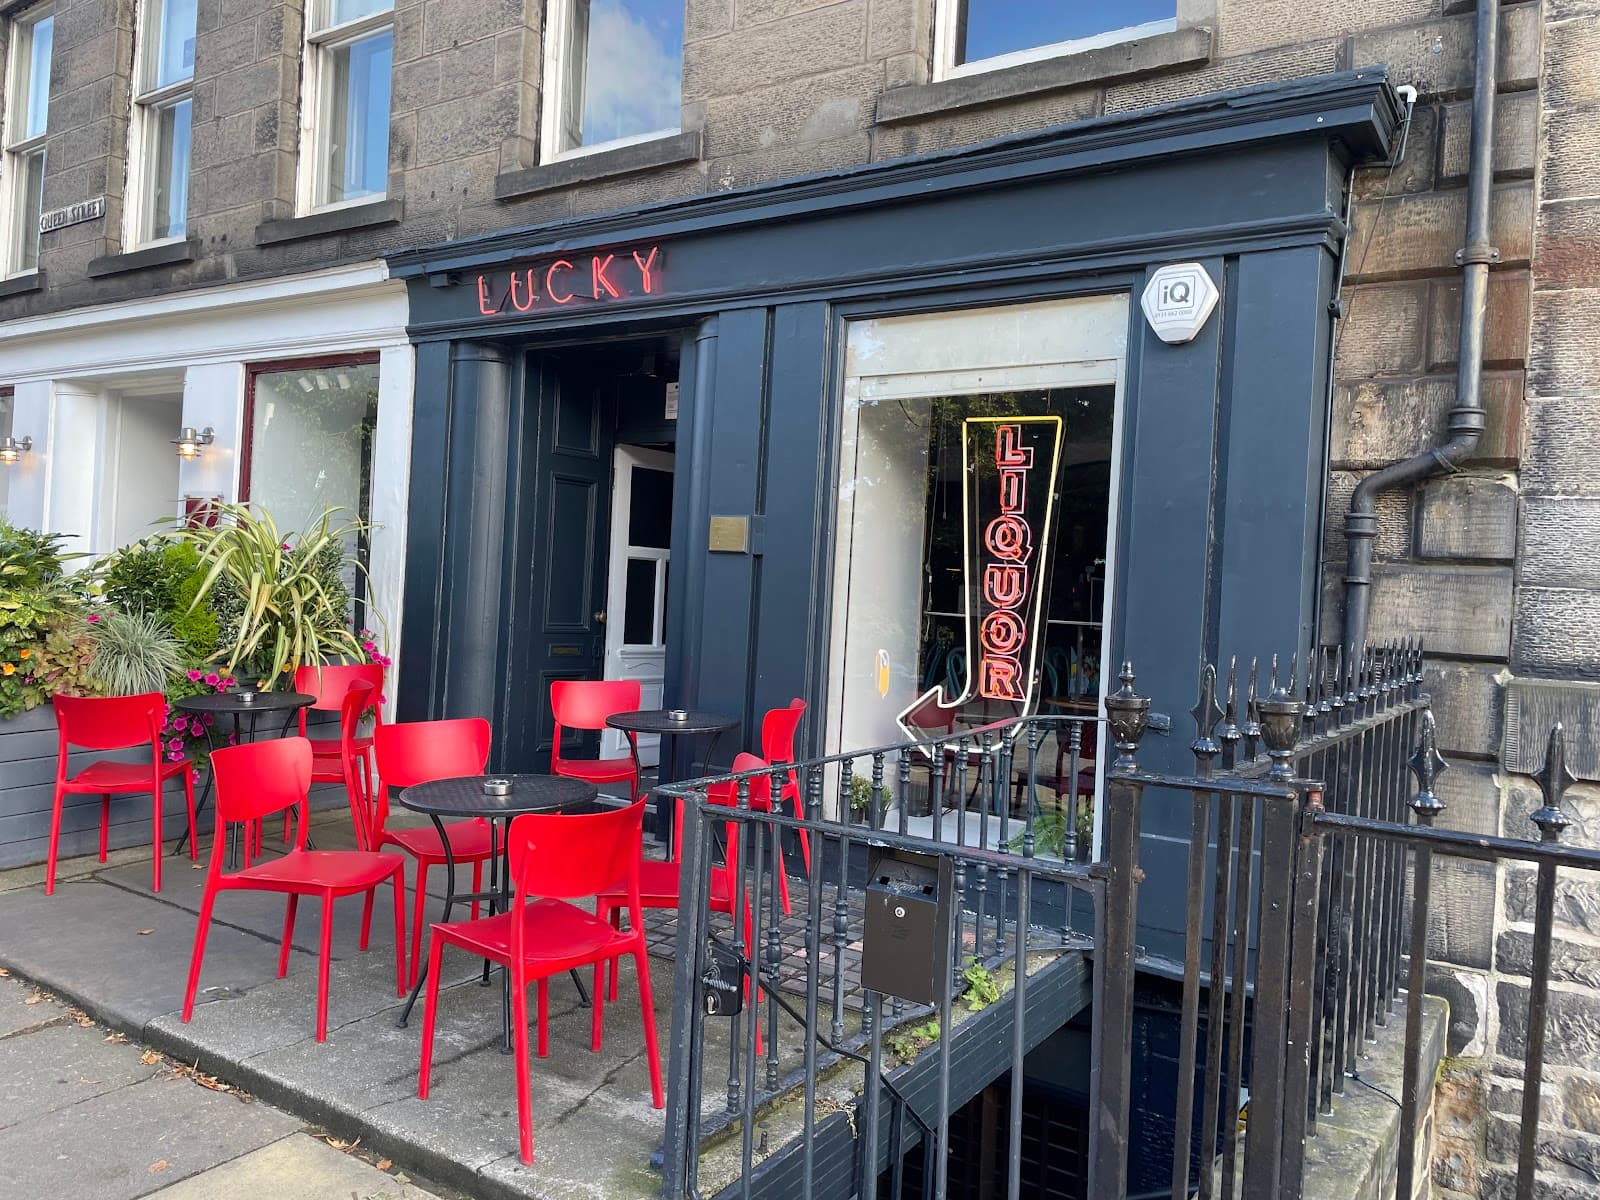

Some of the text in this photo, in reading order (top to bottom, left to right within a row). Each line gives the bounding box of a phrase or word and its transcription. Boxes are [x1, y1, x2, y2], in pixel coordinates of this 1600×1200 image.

[41, 200, 103, 230] QUEEN STREET
[478, 247, 657, 314] LUCKY
[1163, 281, 1190, 304] iQ
[979, 424, 1034, 701] LIQUOR
